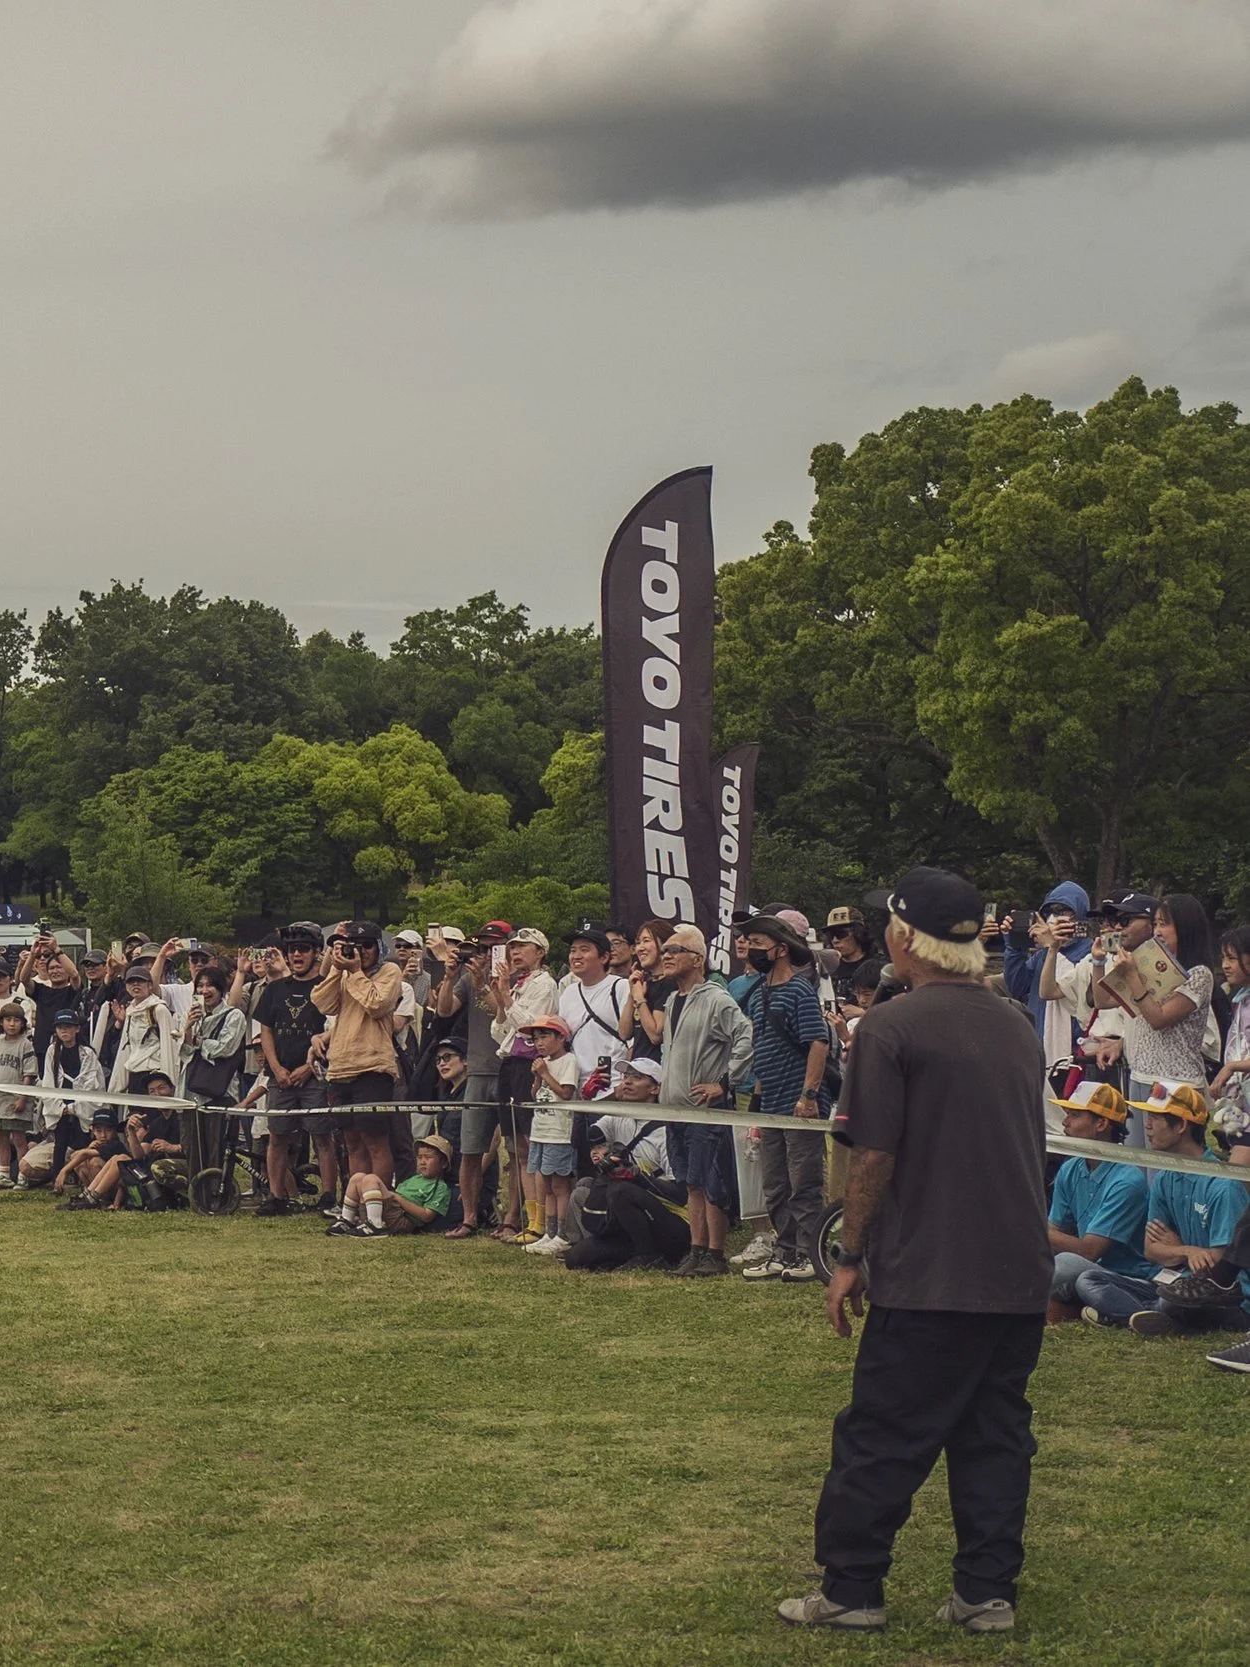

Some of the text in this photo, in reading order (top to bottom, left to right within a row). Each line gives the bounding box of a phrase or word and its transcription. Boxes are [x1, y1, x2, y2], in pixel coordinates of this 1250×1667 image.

[641, 520, 695, 924] TOYO TIRES
[708, 765, 742, 976] TOYO TIRES
